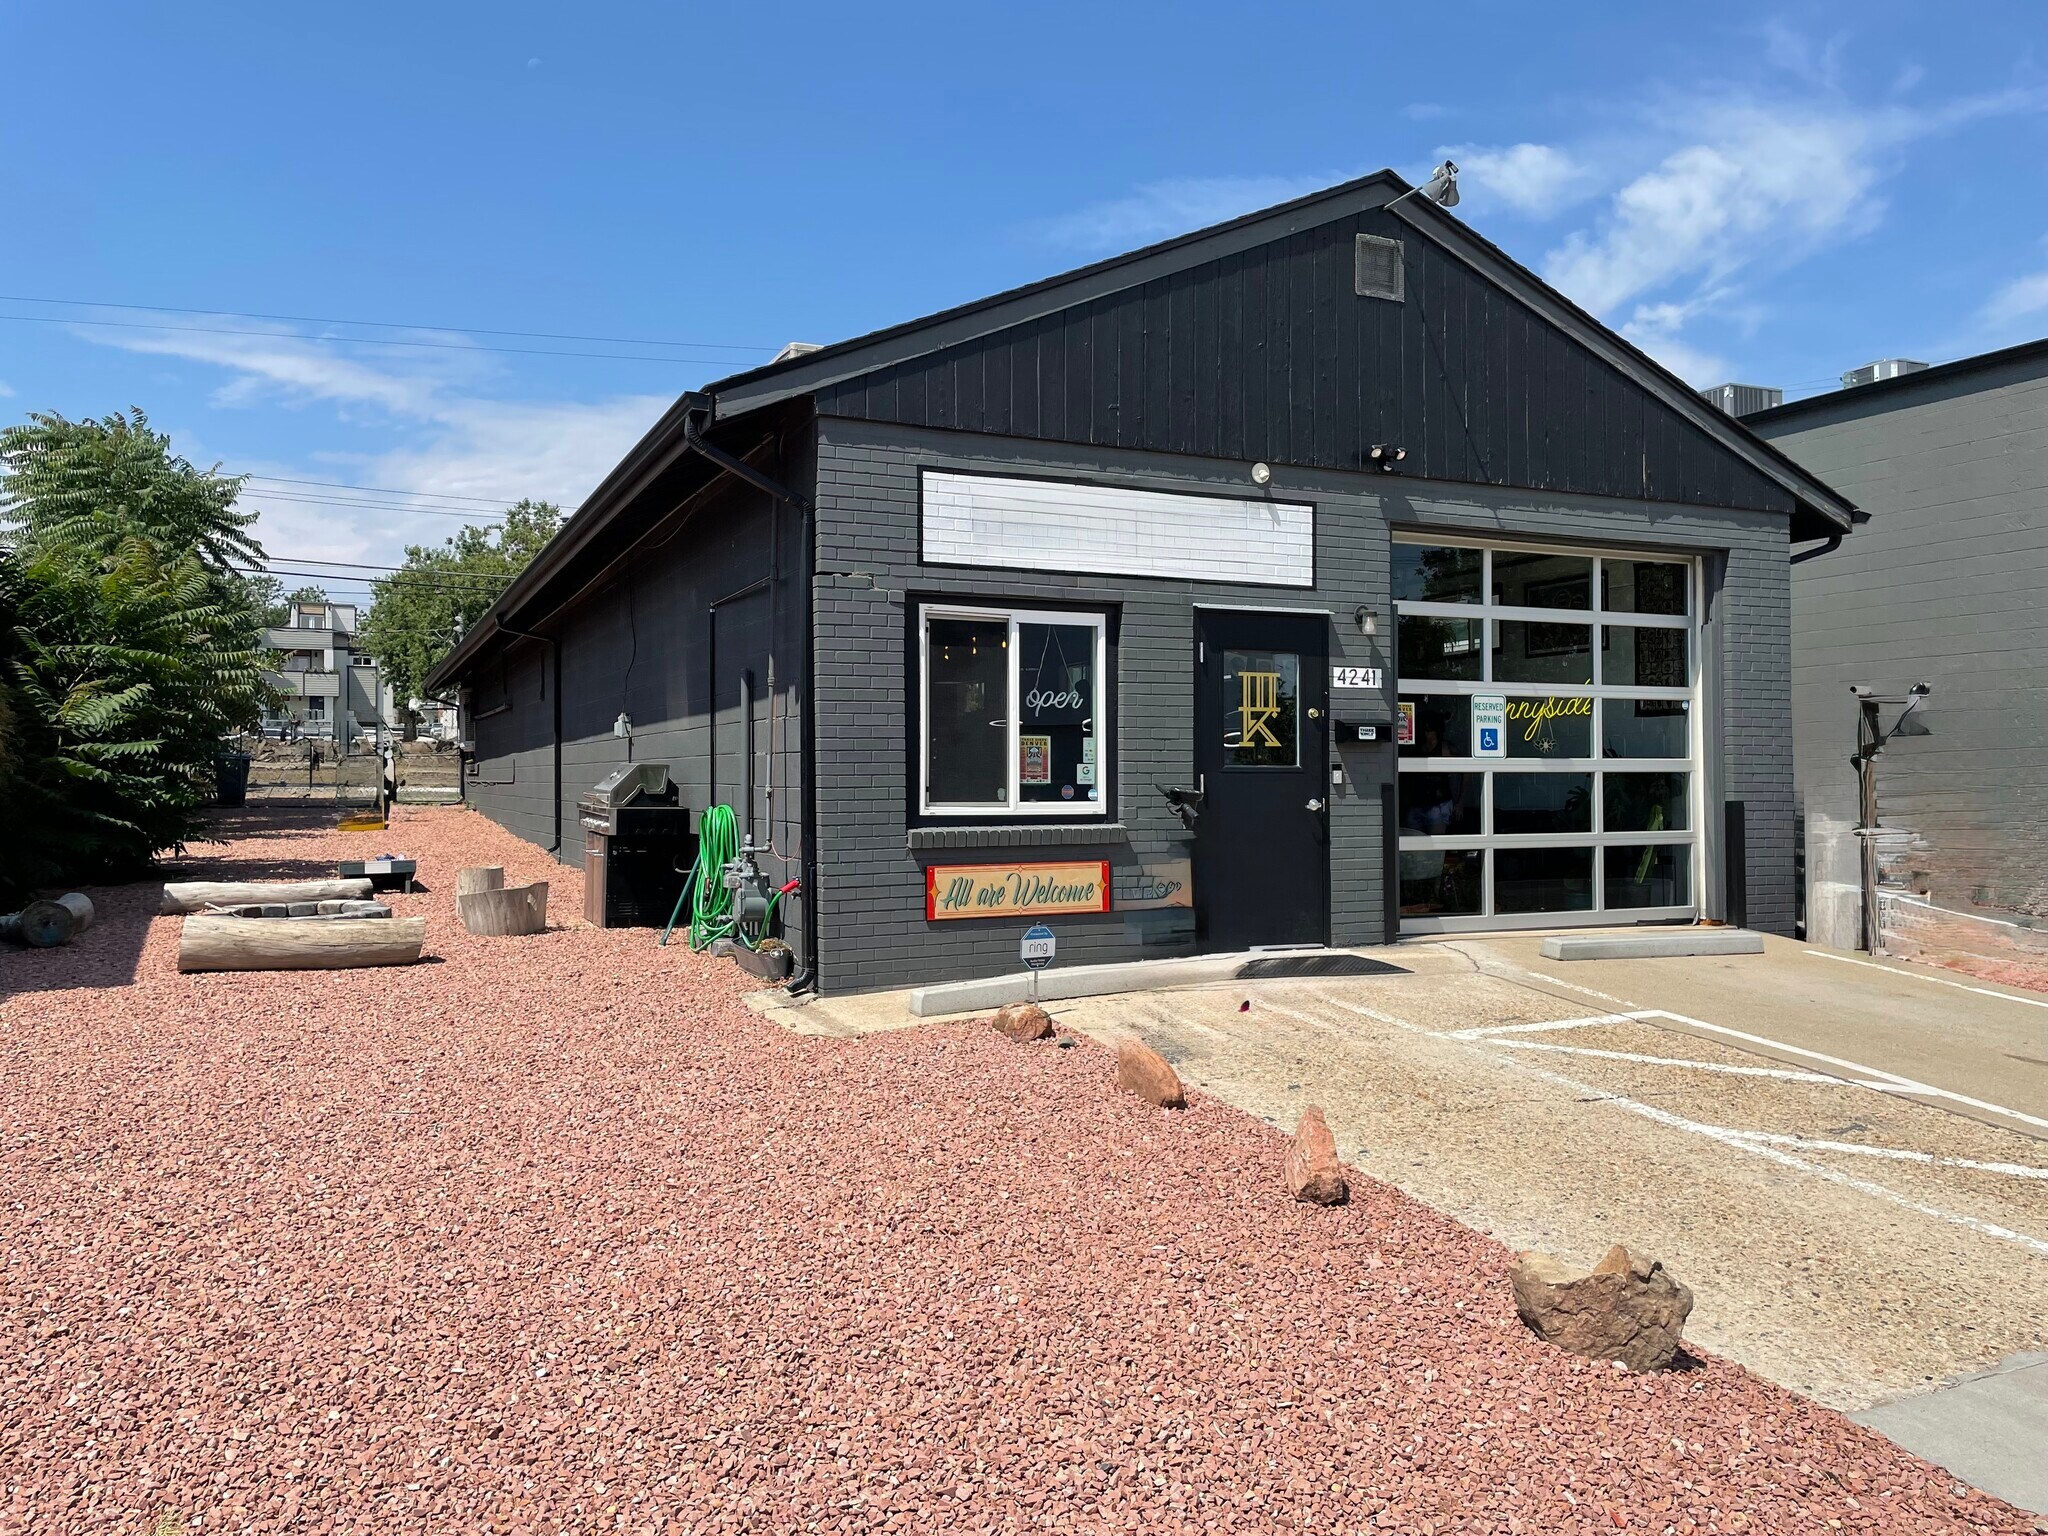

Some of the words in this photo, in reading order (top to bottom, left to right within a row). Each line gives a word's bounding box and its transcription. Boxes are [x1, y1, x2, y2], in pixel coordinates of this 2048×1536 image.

[1337, 669, 1377, 686] 4241
[1025, 688, 1083, 717] open
[1474, 702, 1504, 711] RESERVED
[1476, 715, 1502, 723] PARKING
[1082, 766, 1090, 775] G
[940, 876, 975, 911] All
[976, 881, 1006, 907] are
[1006, 872, 1095, 905] Welcome
[1029, 941, 1048, 955] ring
